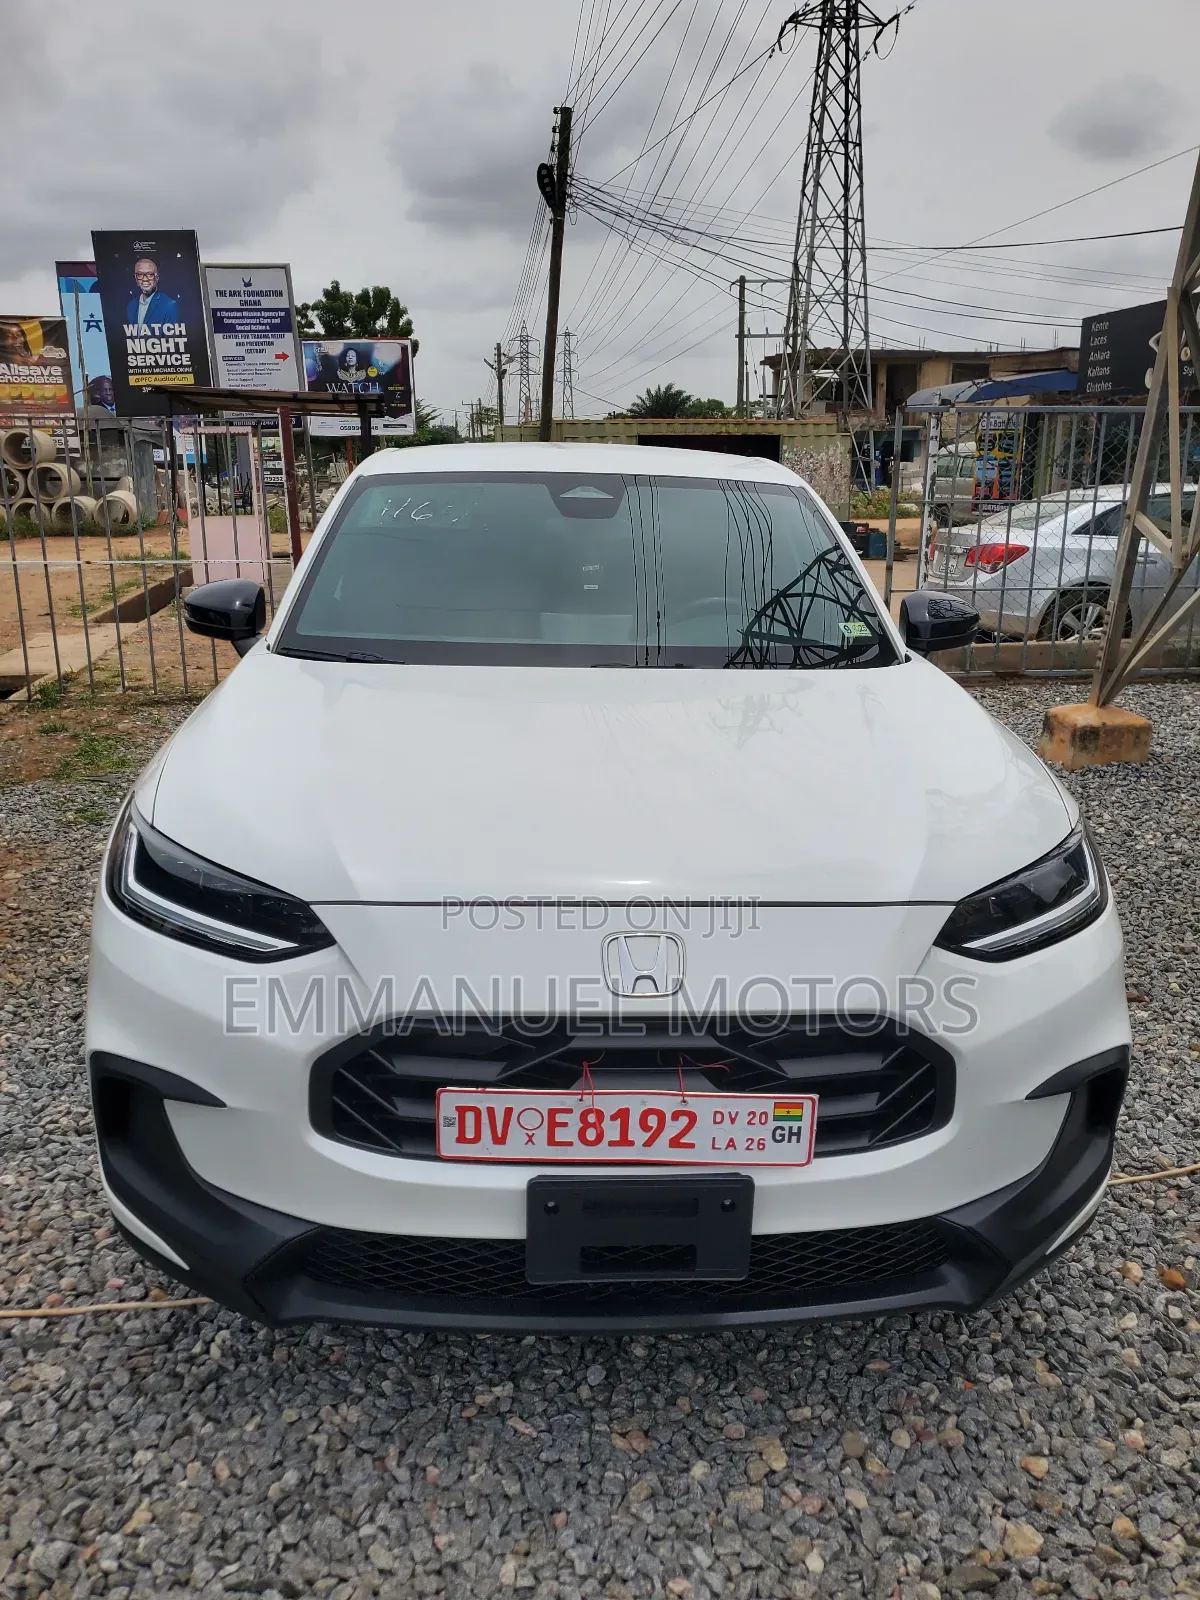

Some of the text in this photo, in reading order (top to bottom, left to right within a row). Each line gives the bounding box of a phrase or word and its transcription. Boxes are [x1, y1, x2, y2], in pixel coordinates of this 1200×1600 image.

[123, 323, 186, 336] WATCH
[1091, 321, 1109, 332] Kente
[126, 338, 187, 353] NIGHT
[1090, 335, 1107, 346] Laces
[128, 354, 191, 366] SERVICE
[1089, 350, 1110, 362] Ankara
[0, 363, 62, 376] Allsave
[1088, 366, 1110, 377] Kaftans
[0, 375, 63, 384] chocolates
[326, 382, 379, 393] WATCH
[1087, 381, 1112, 393] Clutches
[712, 1110, 769, 1126] DV 20
[455, 1105, 514, 1146] DV
[547, 1107, 698, 1149] E8192
[771, 1125, 802, 1144] GH
[711, 1136, 766, 1151] LA 26
